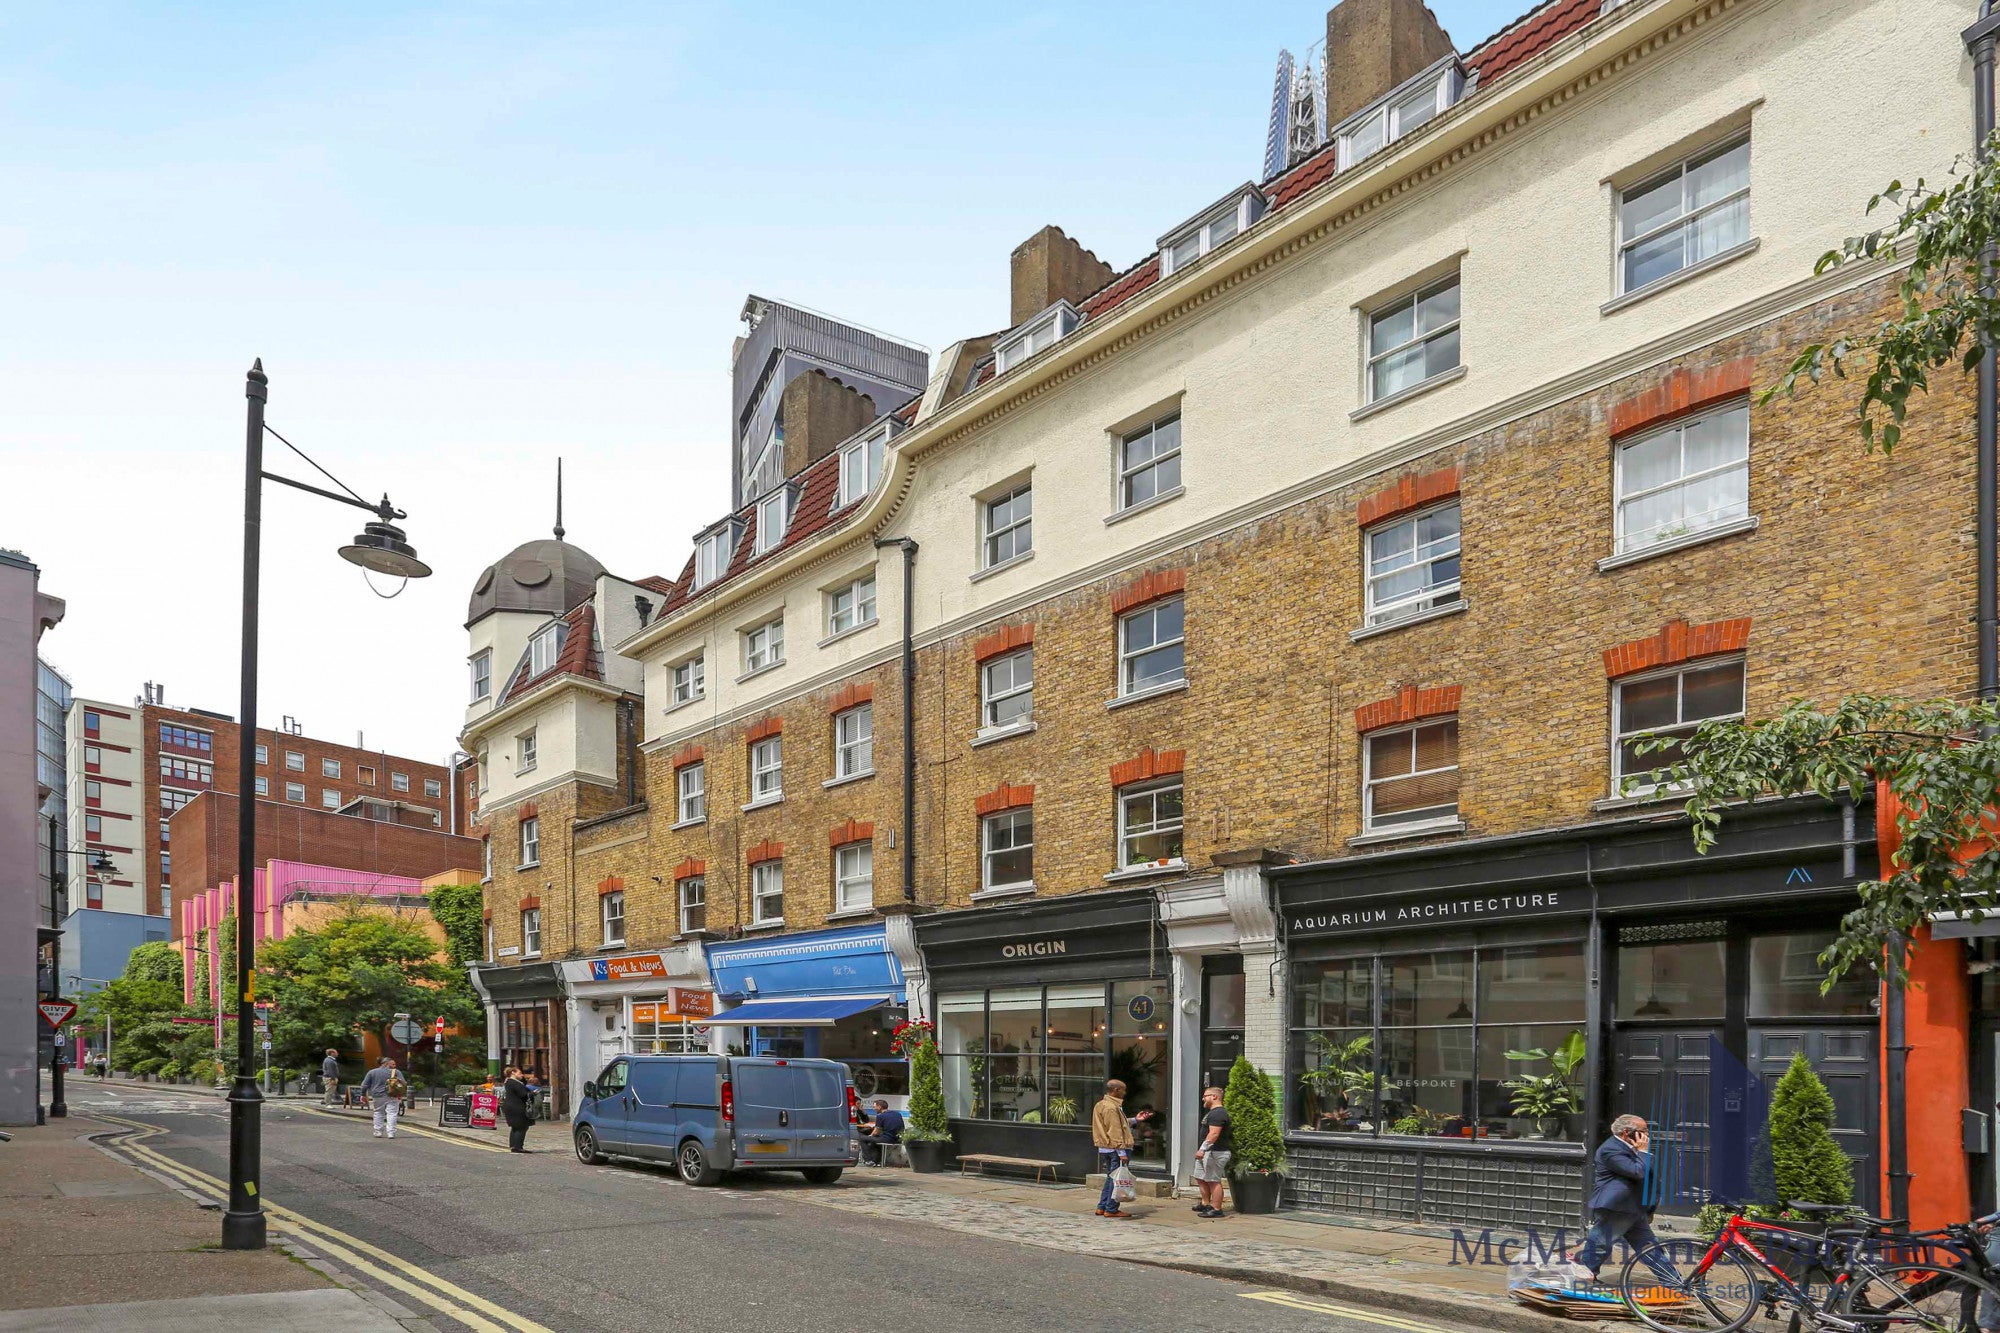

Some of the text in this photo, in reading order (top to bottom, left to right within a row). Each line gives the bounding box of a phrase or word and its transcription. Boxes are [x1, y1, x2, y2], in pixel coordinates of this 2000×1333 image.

[1294, 892, 1559, 930] AQUARIUM ARCHITECTURE
[1002, 940, 1066, 958] ORIGIN
[593, 960, 663, 975] K's Food & News
[681, 991, 707, 1000] Food
[680, 1003, 709, 1012] News
[1132, 1000, 1148, 1014] 41
[996, 1075, 1035, 1085] ORIGIN
[1396, 1079, 1457, 1088] BESPOKE
